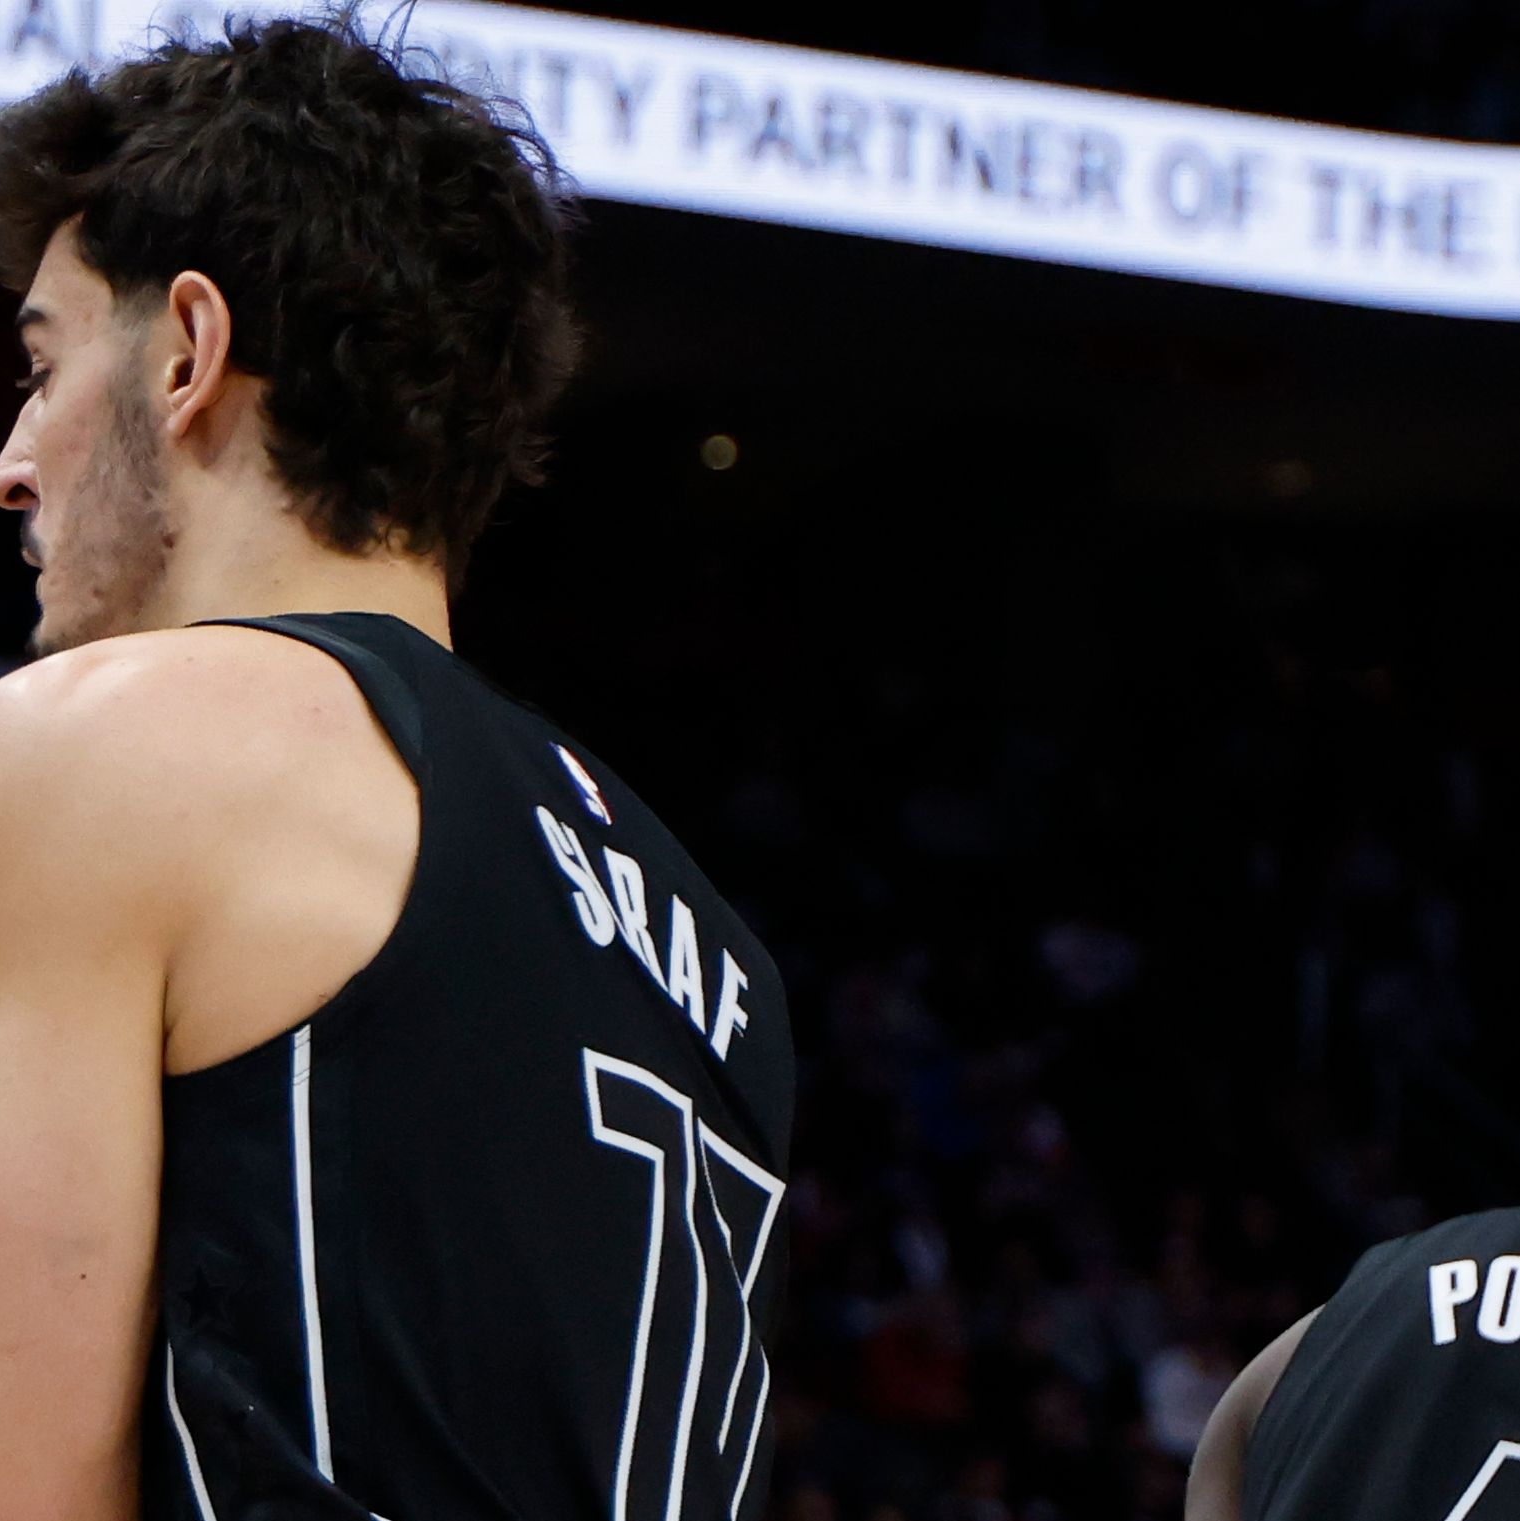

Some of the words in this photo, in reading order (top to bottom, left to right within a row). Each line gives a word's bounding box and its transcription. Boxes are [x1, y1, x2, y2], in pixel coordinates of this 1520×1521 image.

[681, 70, 1129, 216] PARTNER
[1152, 136, 1278, 241] OF
[1308, 156, 1492, 272] THE
